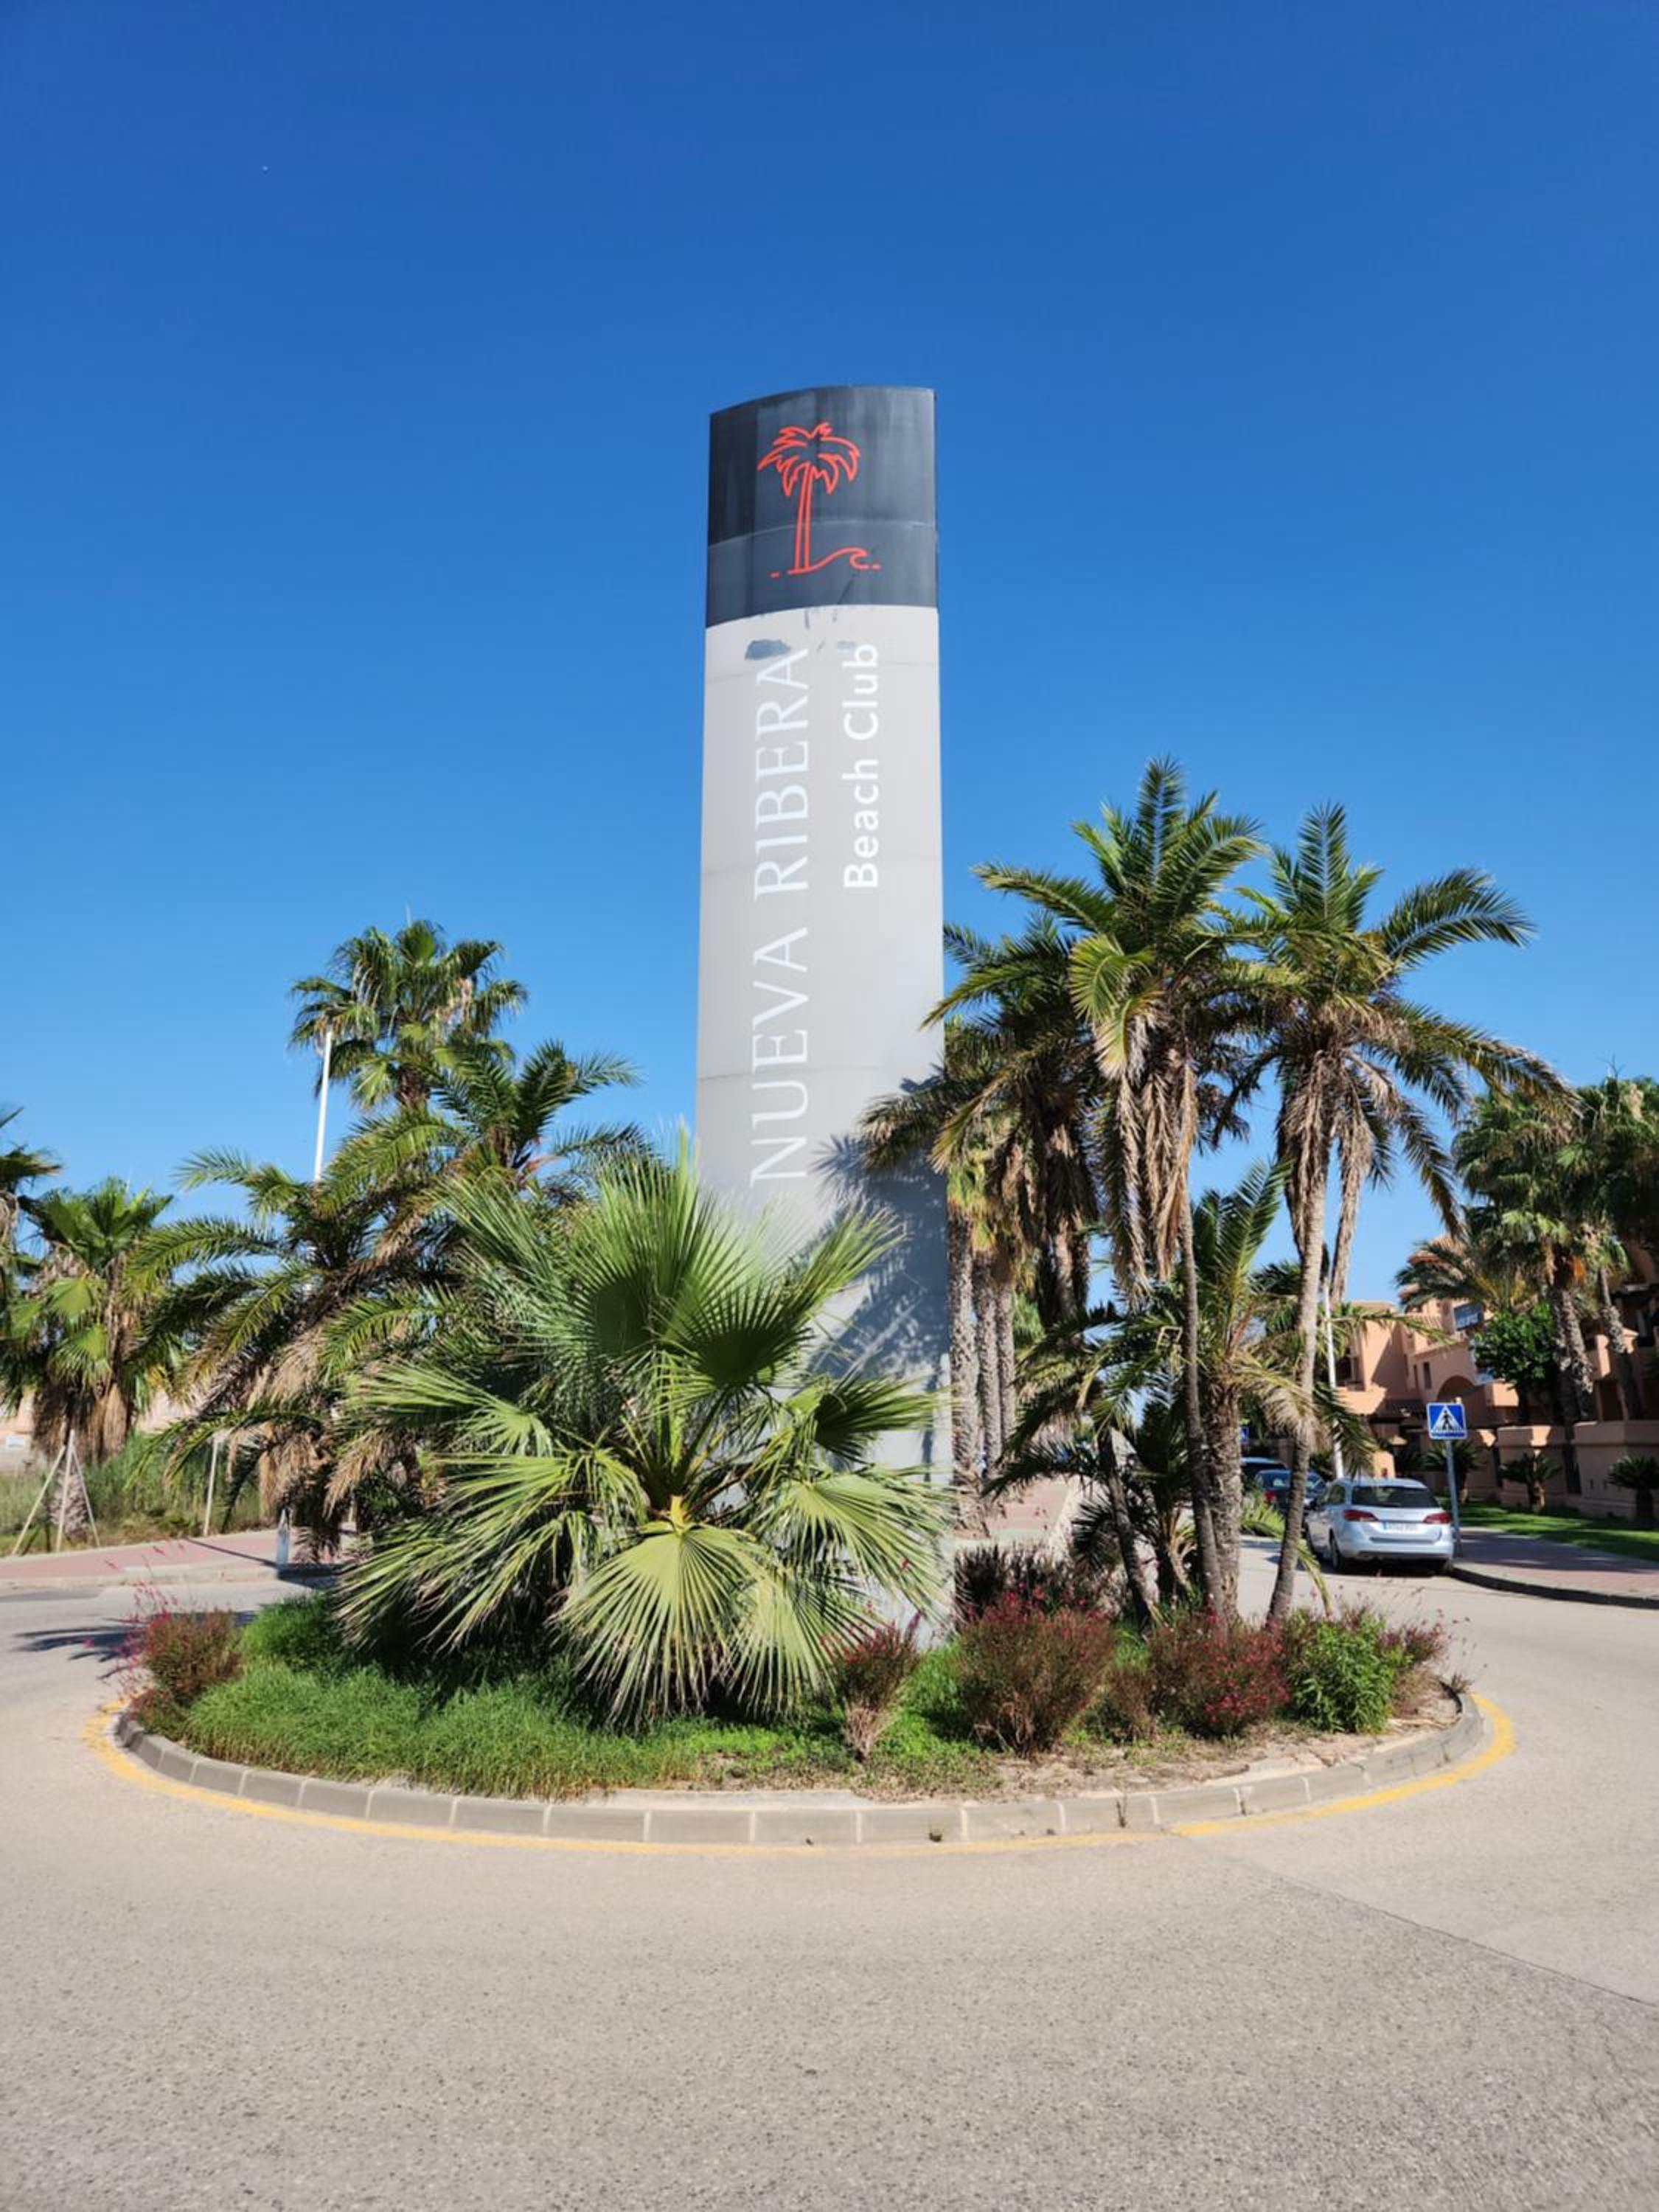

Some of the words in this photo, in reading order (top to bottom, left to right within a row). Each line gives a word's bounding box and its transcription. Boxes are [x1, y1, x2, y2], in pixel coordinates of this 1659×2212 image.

[754, 649, 809, 902] RIBERA
[842, 644, 879, 740] Club
[842, 759, 879, 888] Beach
[751, 927, 809, 1188] NUEVA
